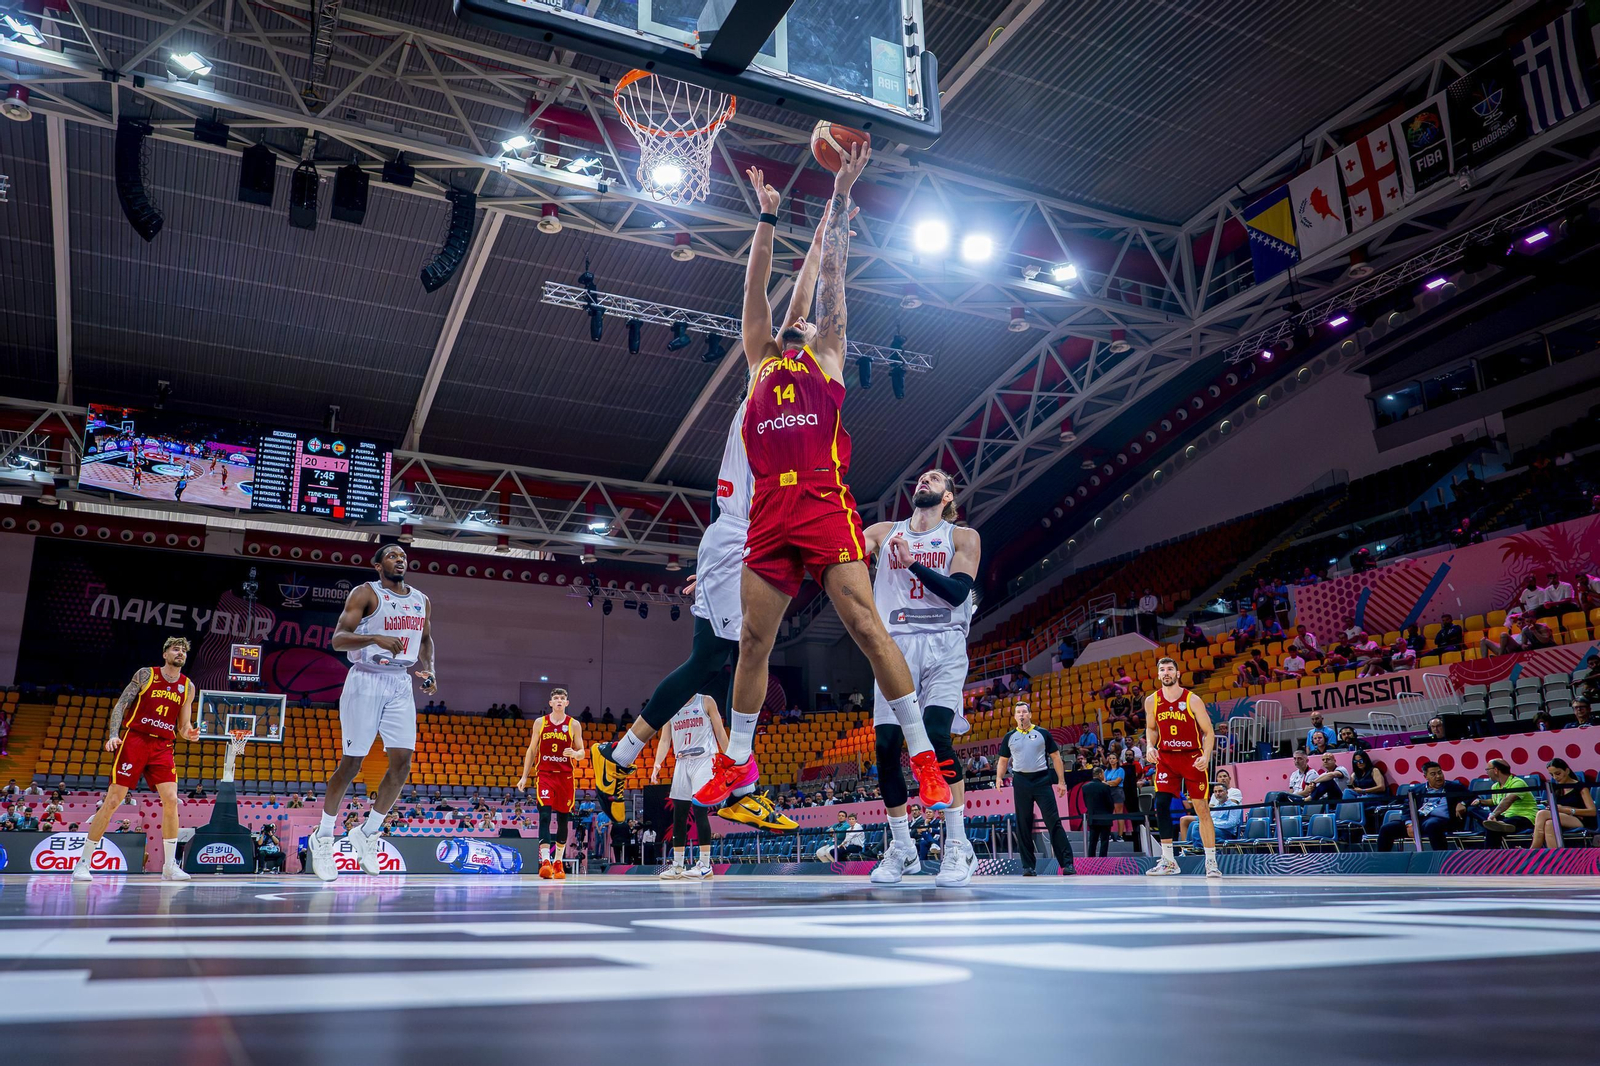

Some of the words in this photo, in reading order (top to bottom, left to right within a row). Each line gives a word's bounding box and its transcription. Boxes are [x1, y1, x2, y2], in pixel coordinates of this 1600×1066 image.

[1472, 115, 1517, 151] EUROBASKET
[1416, 149, 1443, 172] FIBA
[773, 384, 795, 406] 14
[757, 413, 818, 434] endesa
[305, 457, 317, 466] 20
[334, 461, 345, 469] 17
[314, 470, 335, 480] 7:45
[312, 587, 349, 599] EUROBA
[910, 578, 924, 599] 23
[90, 593, 187, 628] MAKE
[191, 607, 273, 641] YOUR
[400, 637, 410, 654] 4
[240, 648, 258, 657] 7:45
[234, 659, 252, 672] 4.1
[151, 690, 181, 705] ESPAÑA
[1297, 675, 1424, 713] LIMASSOL
[156, 704, 169, 717] 41
[1158, 710, 1187, 722] ESPAÑA
[141, 718, 174, 731] endesa
[1170, 725, 1177, 735] 8
[542, 731, 568, 742] ESPAÑA
[552, 744, 558, 752] 3
[956, 748, 966, 760] KE
